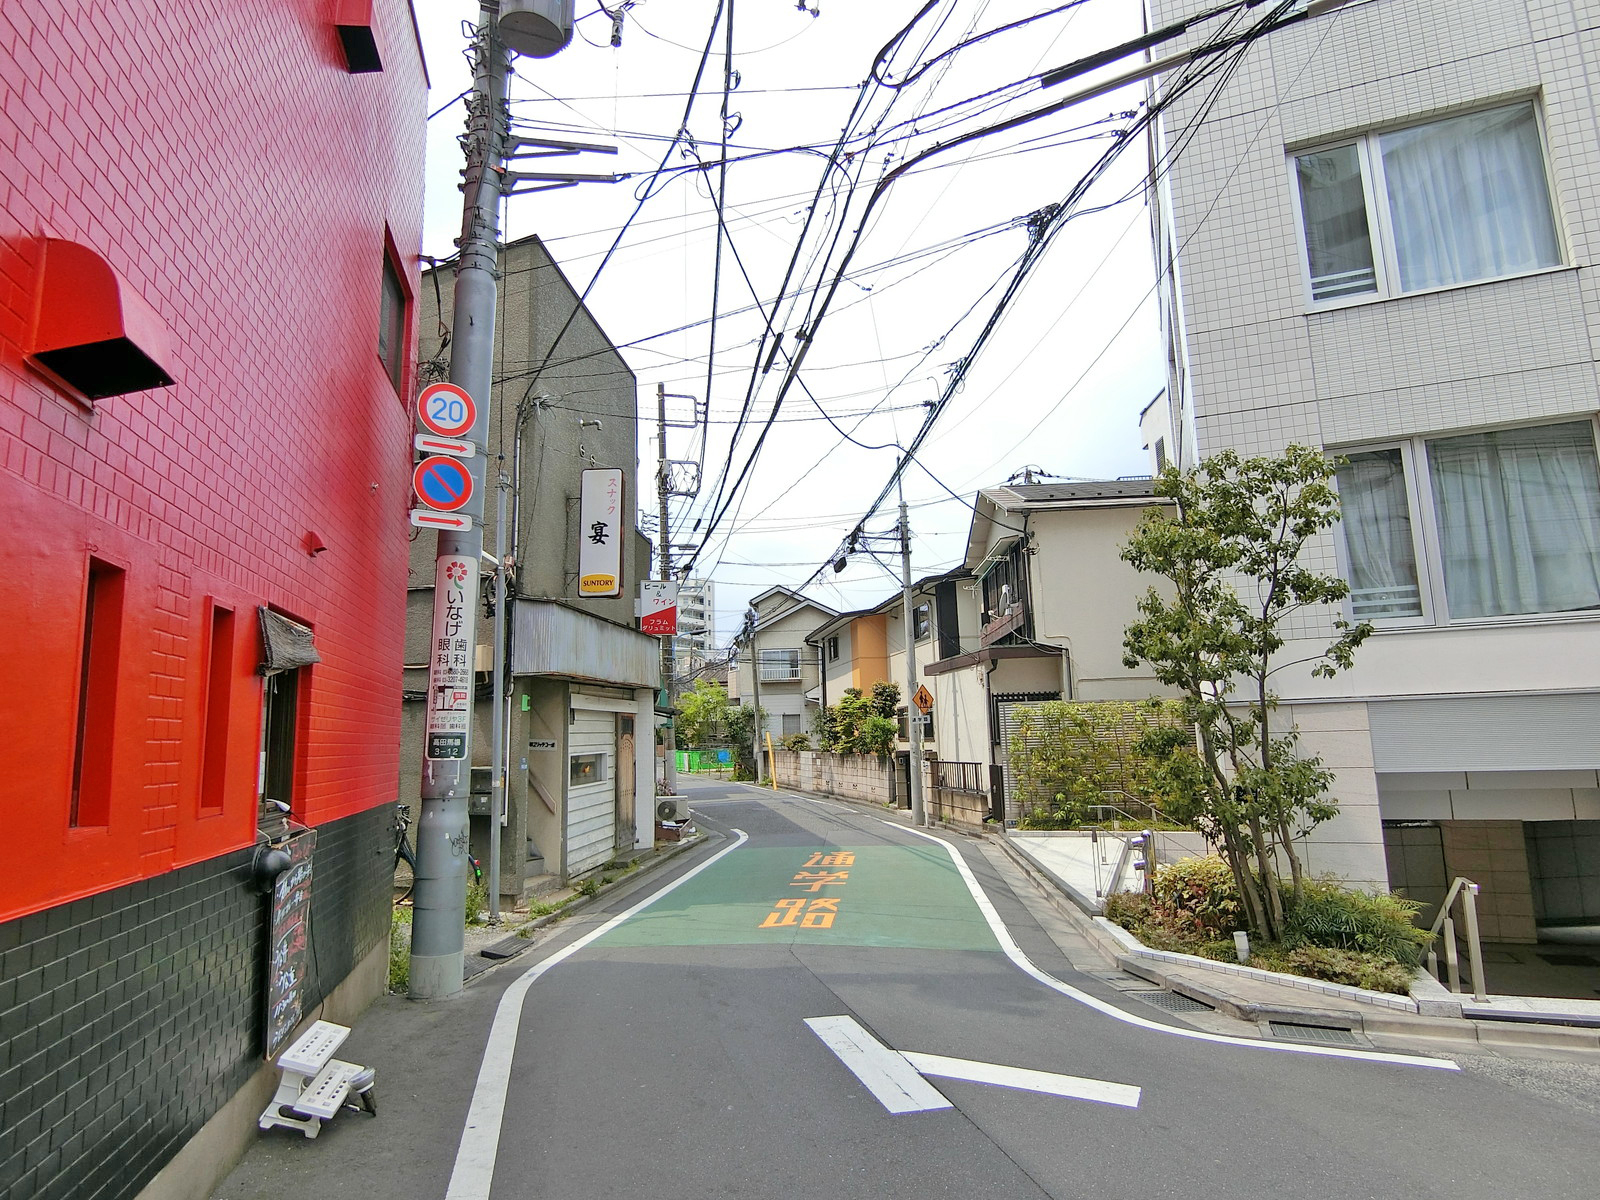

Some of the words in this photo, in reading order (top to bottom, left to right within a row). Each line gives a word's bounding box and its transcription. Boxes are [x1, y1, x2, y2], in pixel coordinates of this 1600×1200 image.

[431, 397, 464, 423] 20
[606, 477, 617, 515] スナック
[588, 520, 609, 545] 宴
[583, 578, 614, 587] SUNTORY
[644, 582, 667, 590] ビール
[445, 589, 464, 637] いなげ
[653, 598, 675, 606] ワイン
[436, 638, 451, 667] 眼科
[453, 638, 467, 667] 歯科
[758, 850, 856, 929] 通学路
